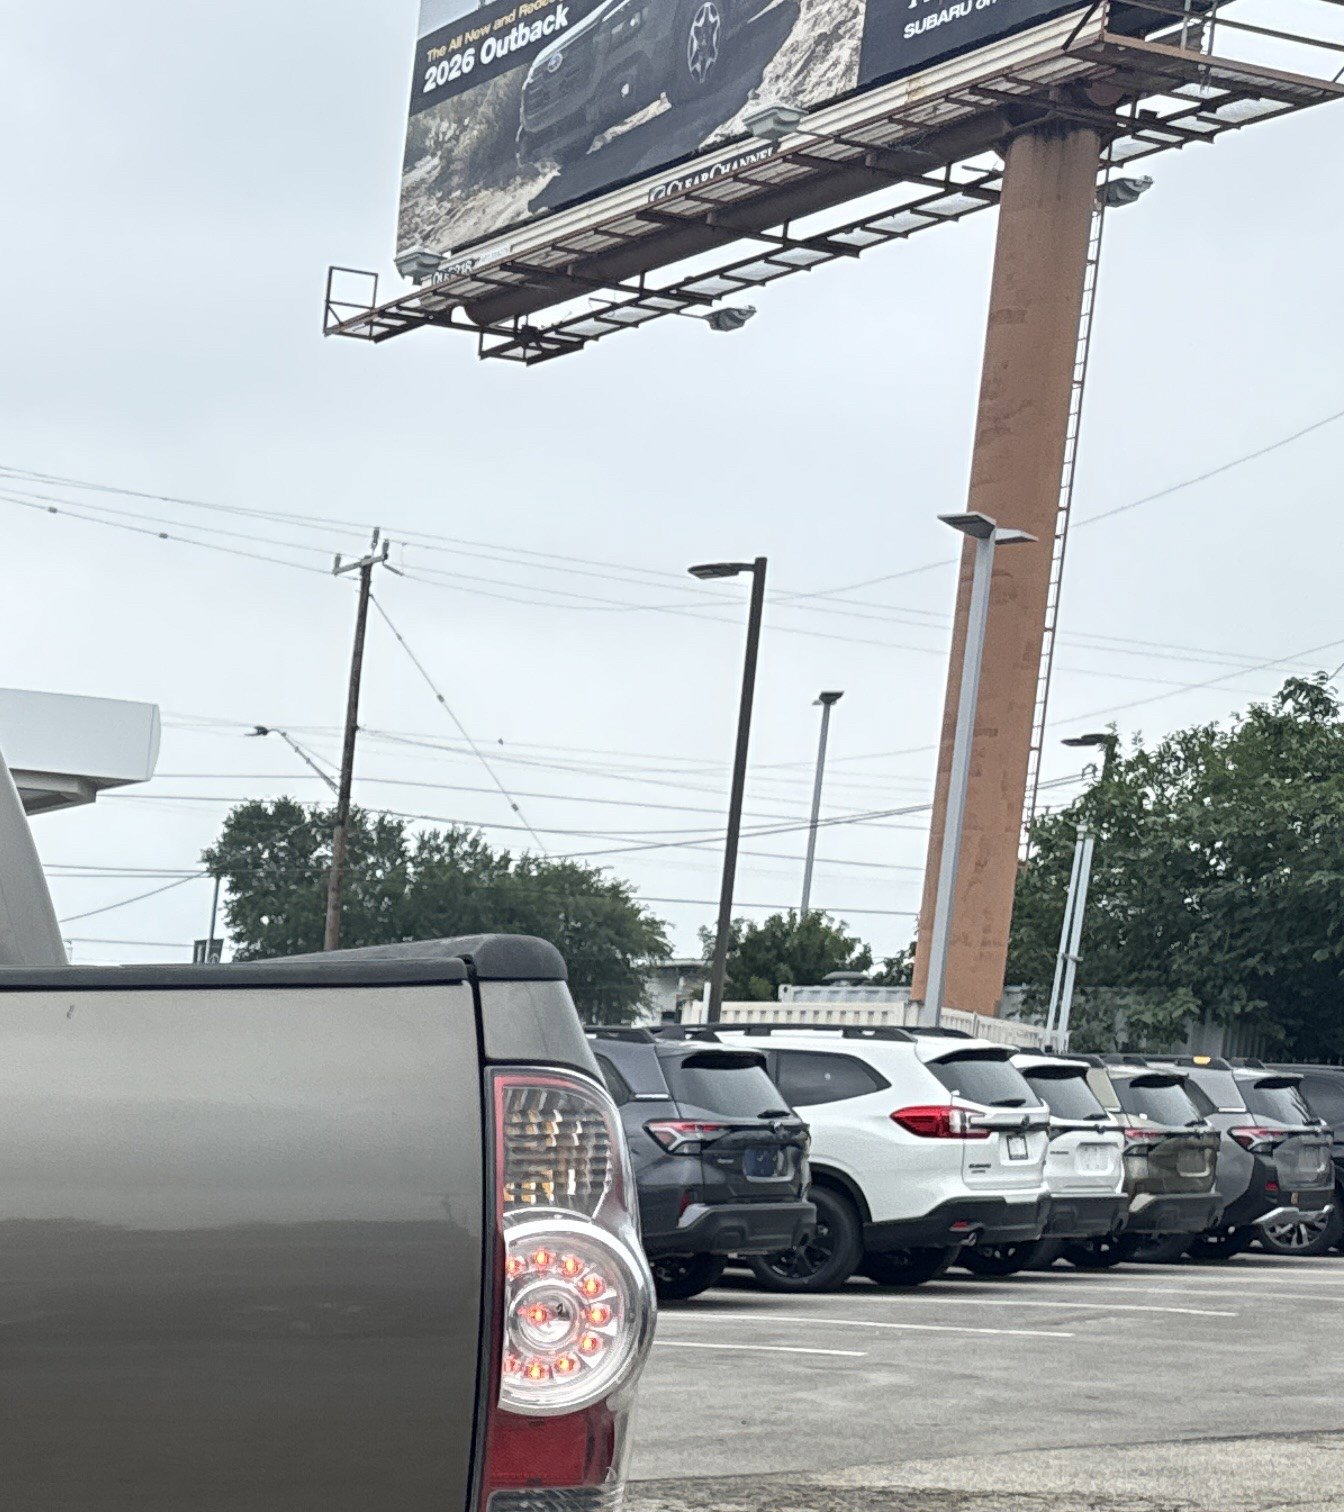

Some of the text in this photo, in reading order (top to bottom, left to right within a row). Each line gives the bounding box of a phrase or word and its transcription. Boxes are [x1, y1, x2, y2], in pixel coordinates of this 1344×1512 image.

[427, 45, 446, 62] The
[447, 36, 463, 53] All
[464, 23, 492, 45] New
[493, 13, 516, 31] and
[903, 0, 972, 39] SUBARU
[423, 4, 570, 94] 2026 Outback
